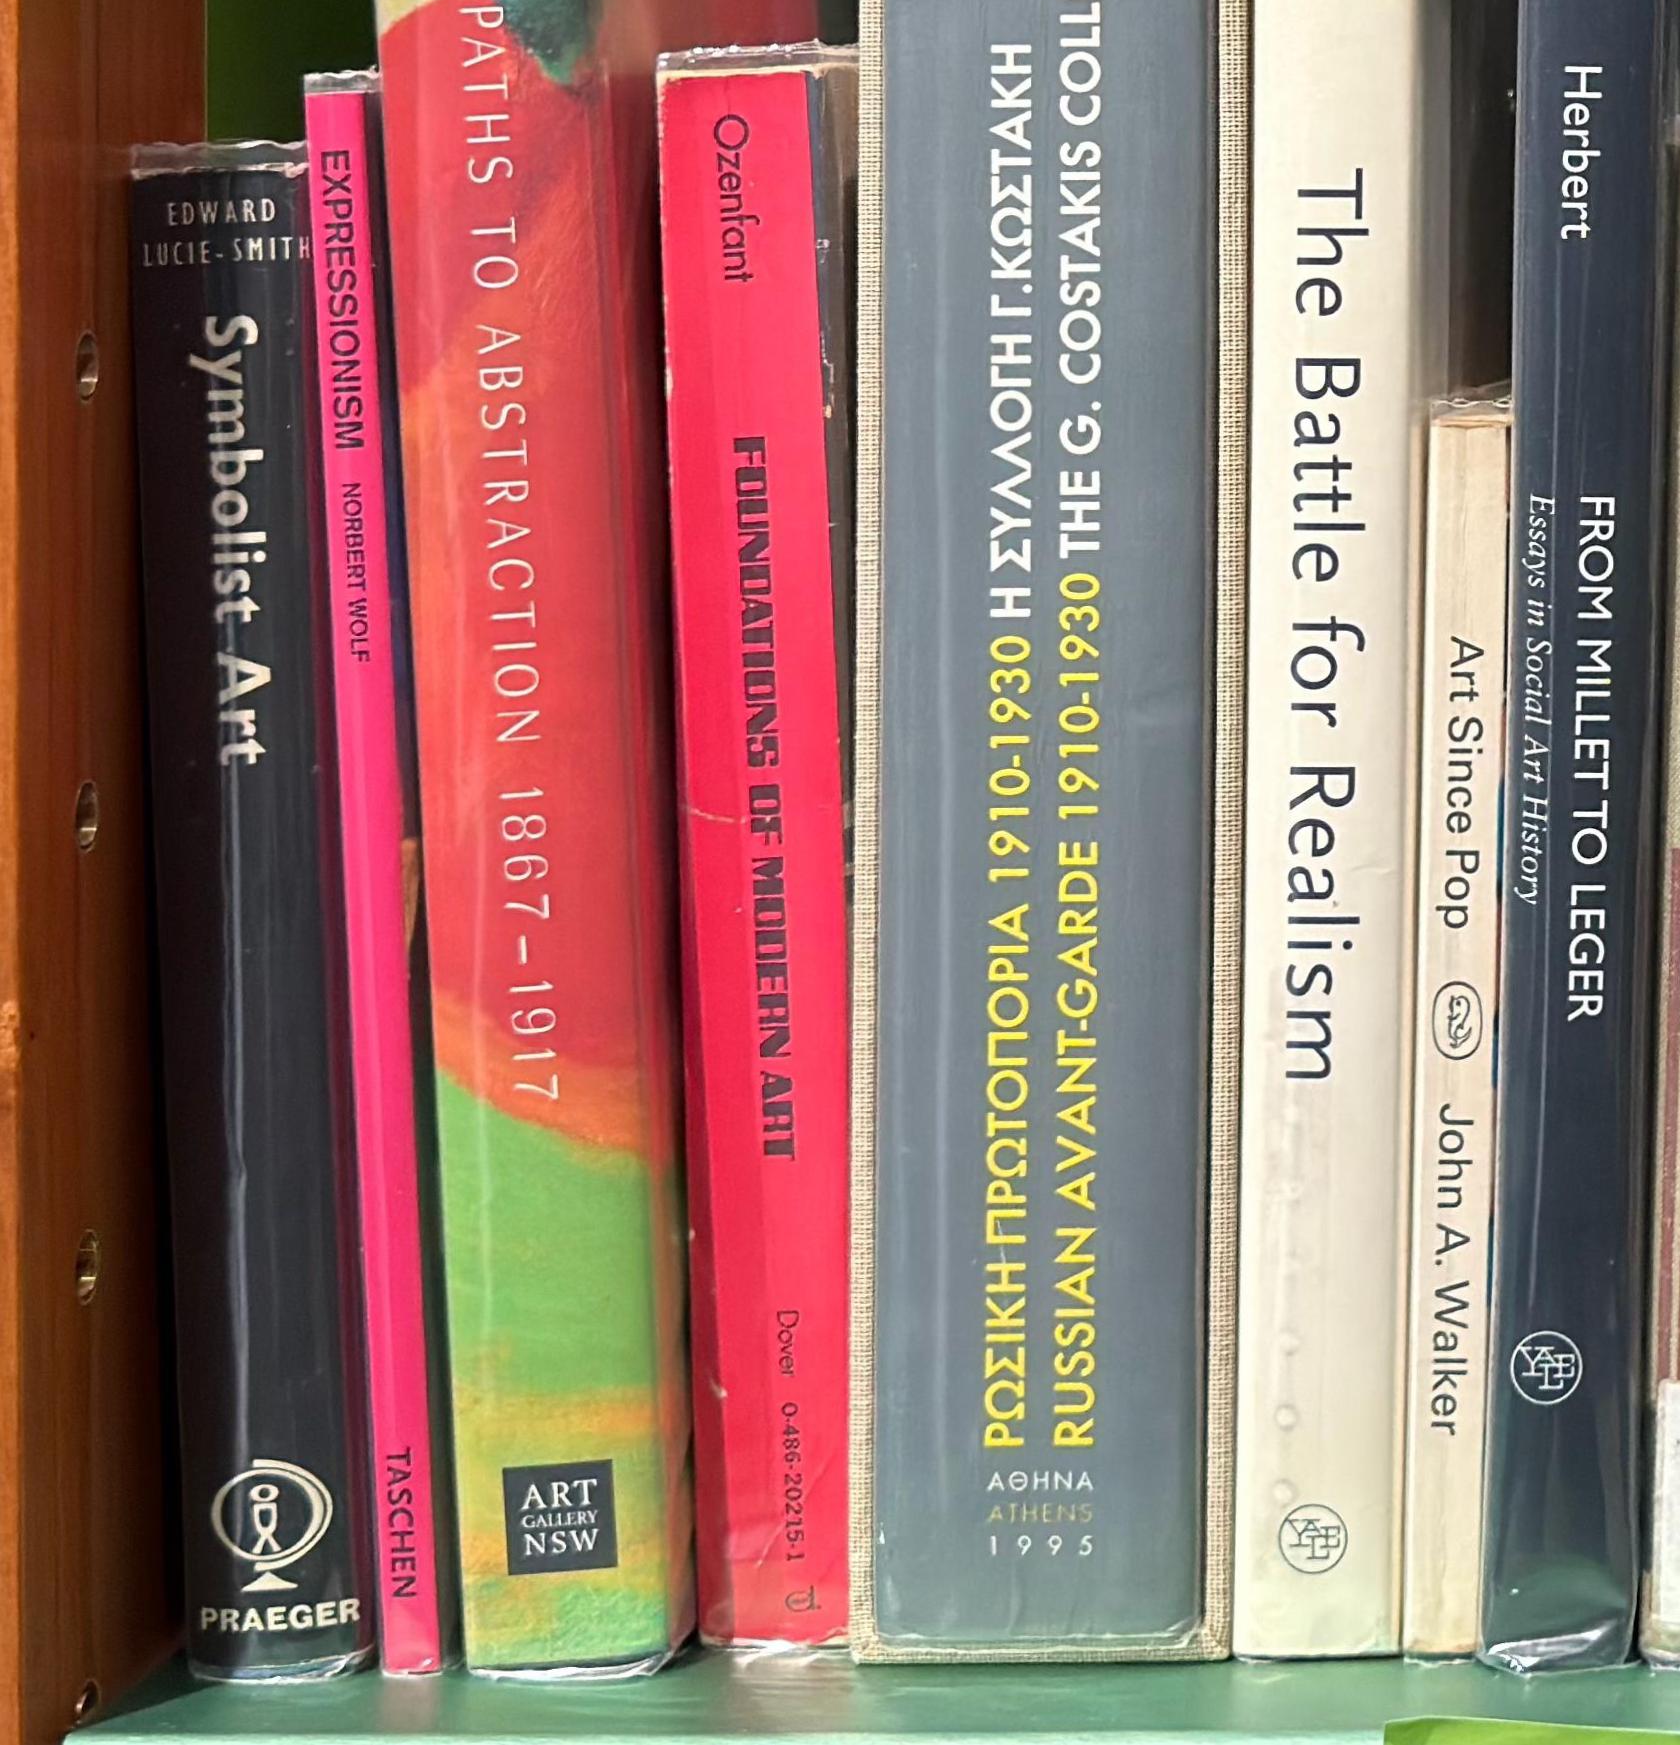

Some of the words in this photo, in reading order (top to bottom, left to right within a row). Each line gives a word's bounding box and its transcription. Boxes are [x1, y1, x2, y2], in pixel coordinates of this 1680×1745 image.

[459, 6, 514, 184] PATHS
[713, 114, 760, 283] Ozenfant
[1560, 65, 1603, 239] Herbert
[142, 241, 313, 268] LUCIE-SMITH
[166, 201, 277, 225] EDWARD
[470, 218, 519, 290] TO
[1057, 142, 1101, 385] COSTAKIS
[1295, 167, 1369, 317] The
[320, 150, 364, 449] EXPRESSIONISM
[189, 315, 267, 623] Symbolist
[989, 334, 1032, 572] ΣΥΛΛΟΓΗ
[1058, 402, 1101, 455] G.
[1291, 356, 1366, 583] Battle
[342, 482, 367, 592] NORBERT
[475, 325, 541, 743] ABSTRACTION
[1058, 471, 1100, 559] THE
[1521, 494, 1555, 588] Essays
[1578, 496, 1615, 619] FROM
[347, 599, 370, 662] WOLF
[734, 437, 780, 767] FOUNDATIONS
[1525, 599, 1553, 626] in
[217, 652, 271, 765] Art
[1057, 573, 1101, 821] 1910-1930
[1289, 617, 1365, 727] for
[1448, 636, 1482, 702] Art
[1523, 637, 1553, 724] Social
[1574, 639, 1612, 790] MILLET
[988, 636, 1031, 884] 1910-1930
[1445, 715, 1480, 834] Since
[1522, 733, 1550, 782] Art
[751, 785, 783, 846] OF
[1513, 794, 1548, 905] History
[1571, 800, 1608, 866] TO
[1284, 767, 1361, 1079] Realism
[1441, 849, 1479, 929] Pop
[753, 856, 793, 1057] MODERN
[1568, 884, 1606, 1022] LEGER
[986, 904, 1028, 1245] ΠΡΩΤΟΠΟΡΙΑ
[1055, 842, 1099, 1211] AVANT-GARDE
[759, 1071, 796, 1161] ART
[1435, 1103, 1475, 1209] John
[1434, 1223, 1470, 1266] A.
[984, 1262, 1027, 1447] ΡΩΣΙΚΗ
[1053, 1226, 1097, 1447] RUSSIAN
[1429, 1281, 1470, 1436] Walker
[385, 1447, 417, 1598] TASCHEN
[520, 1479, 598, 1511] ART
[520, 1508, 598, 1529] GALLERY
[987, 1471, 1094, 1492] ΑΘΗΝΑ
[988, 1503, 1093, 1524] ATHENS
[523, 1528, 599, 1556] NSW
[990, 1535, 1093, 1556] 1995
[200, 1598, 361, 1631] PRAEGER
